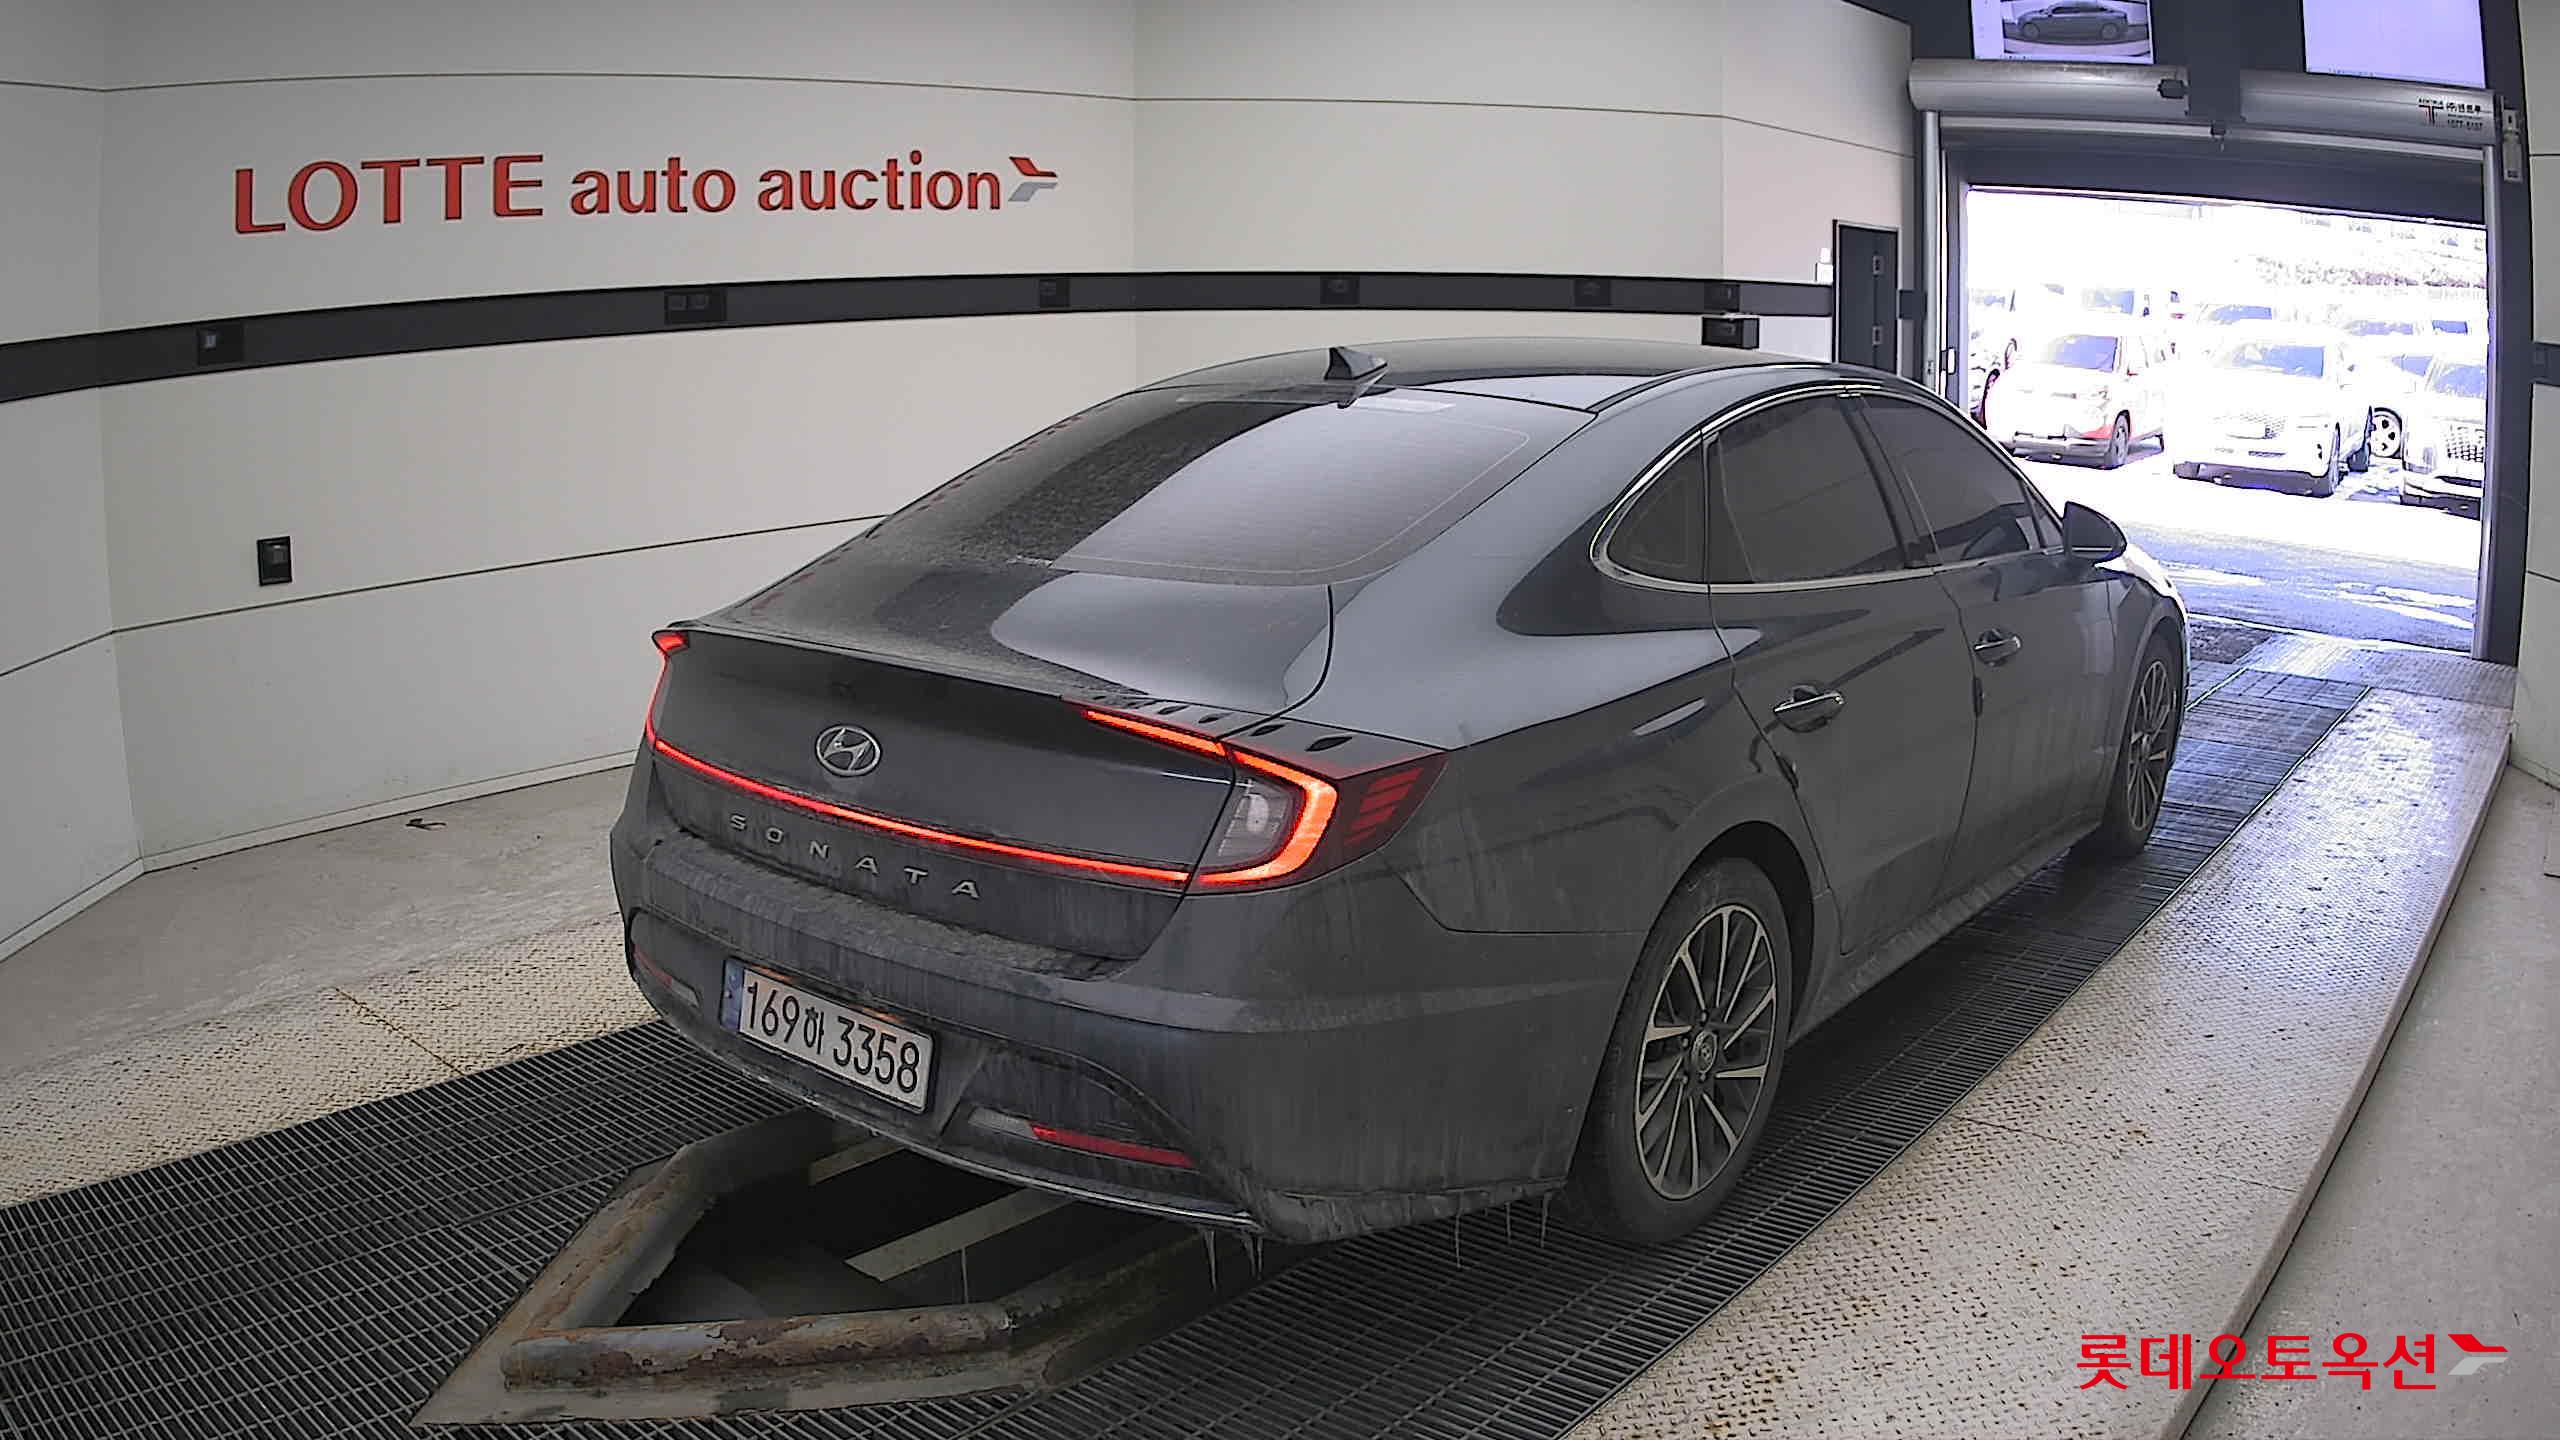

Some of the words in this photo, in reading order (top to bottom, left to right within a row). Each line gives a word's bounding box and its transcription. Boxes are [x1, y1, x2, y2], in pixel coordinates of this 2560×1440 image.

[235, 154, 543, 234] LOTTE
[570, 157, 737, 217] auto
[758, 150, 1002, 212] auction
[730, 814, 980, 899] SONATA
[747, 981, 825, 1055] 169하
[833, 1015, 920, 1093] 3358
